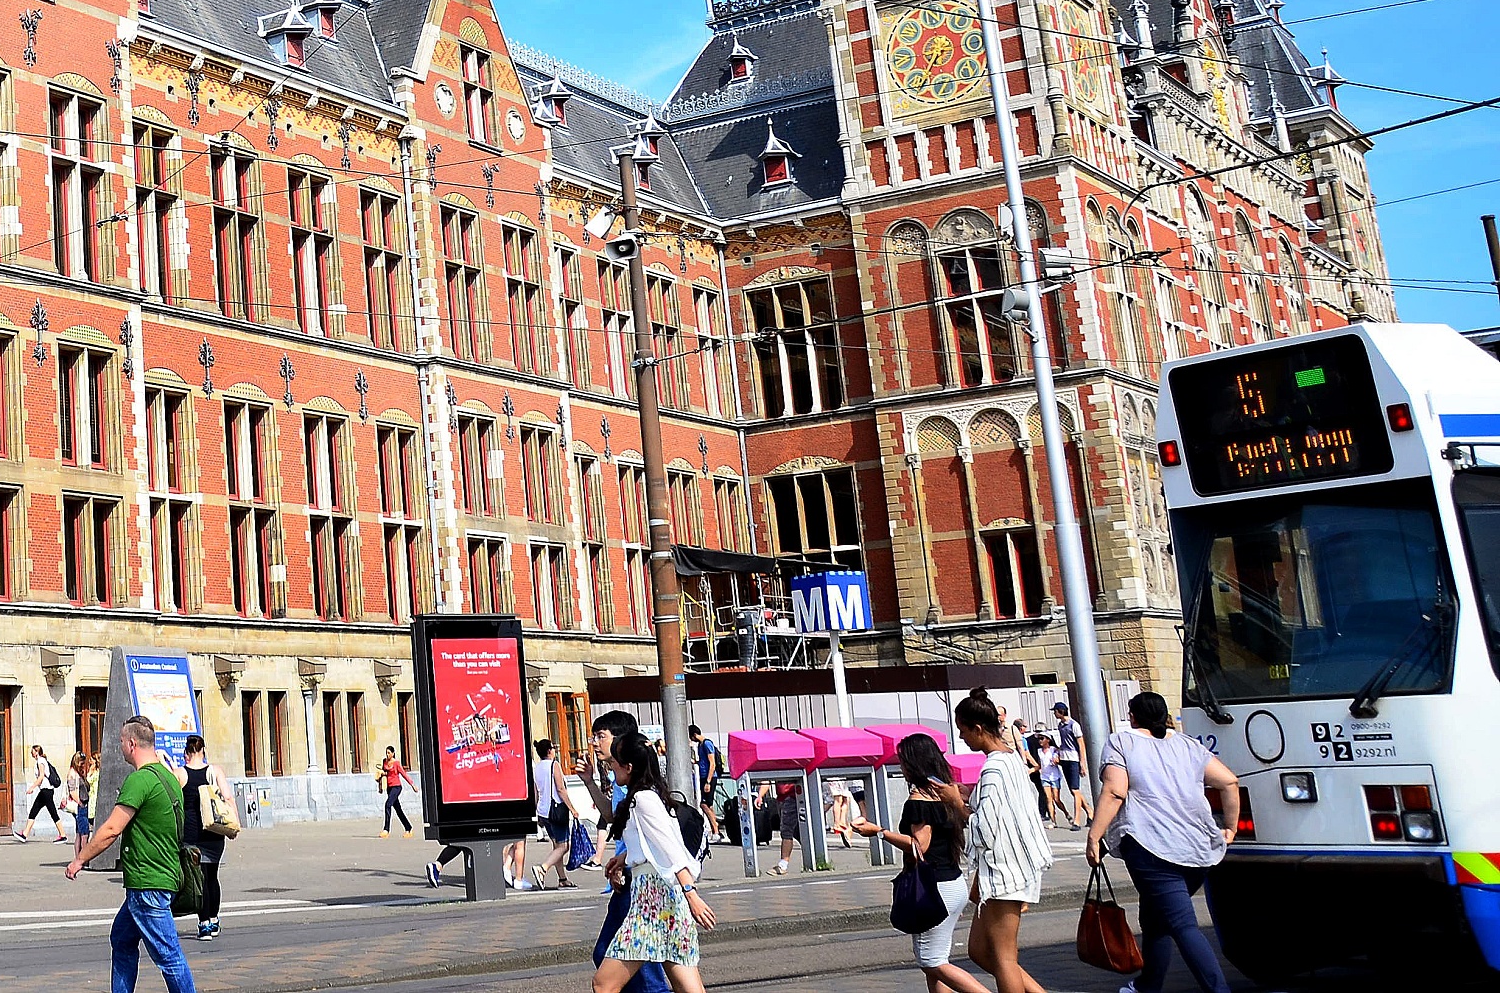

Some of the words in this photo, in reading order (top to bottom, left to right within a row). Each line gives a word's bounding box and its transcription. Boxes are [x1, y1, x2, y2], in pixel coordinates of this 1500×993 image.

[791, 587, 826, 634] M
[826, 584, 866, 630] M
[441, 652, 452, 660] The
[453, 652, 466, 660] card
[466, 652, 478, 660] that
[455, 759, 475, 769] city
[475, 752, 495, 764] card
[1355, 746, 1396, 758] 9292.nl
